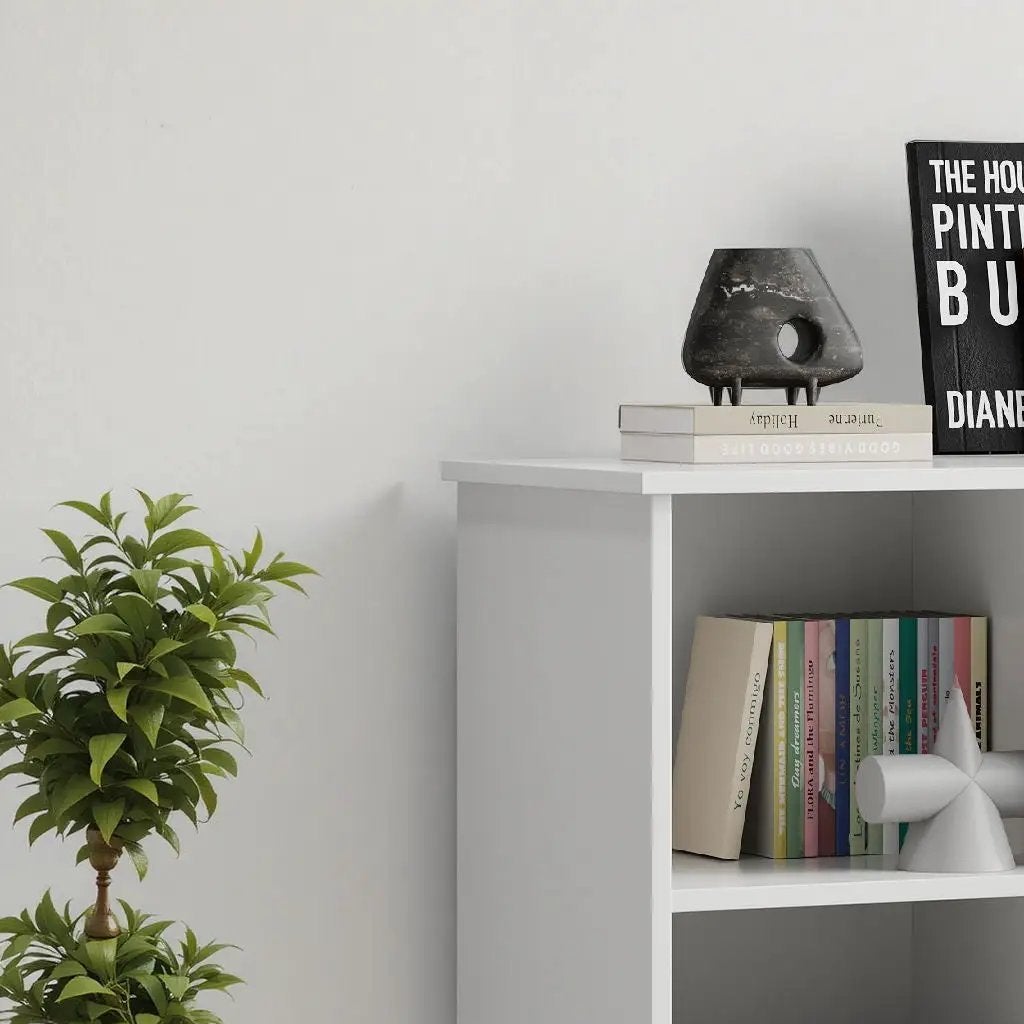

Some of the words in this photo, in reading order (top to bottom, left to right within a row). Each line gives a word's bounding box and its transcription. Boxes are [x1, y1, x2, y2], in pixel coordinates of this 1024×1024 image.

[929, 159, 976, 194] THE
[936, 260, 1019, 327] BU
[888, 649, 896, 714] Monsters
[745, 672, 761, 746] conmigo
[853, 704, 861, 724] de
[806, 725, 814, 746] the
[888, 720, 896, 743] the
[740, 753, 751, 782] voy
[806, 750, 814, 776] and
[733, 789, 744, 811] Yo
